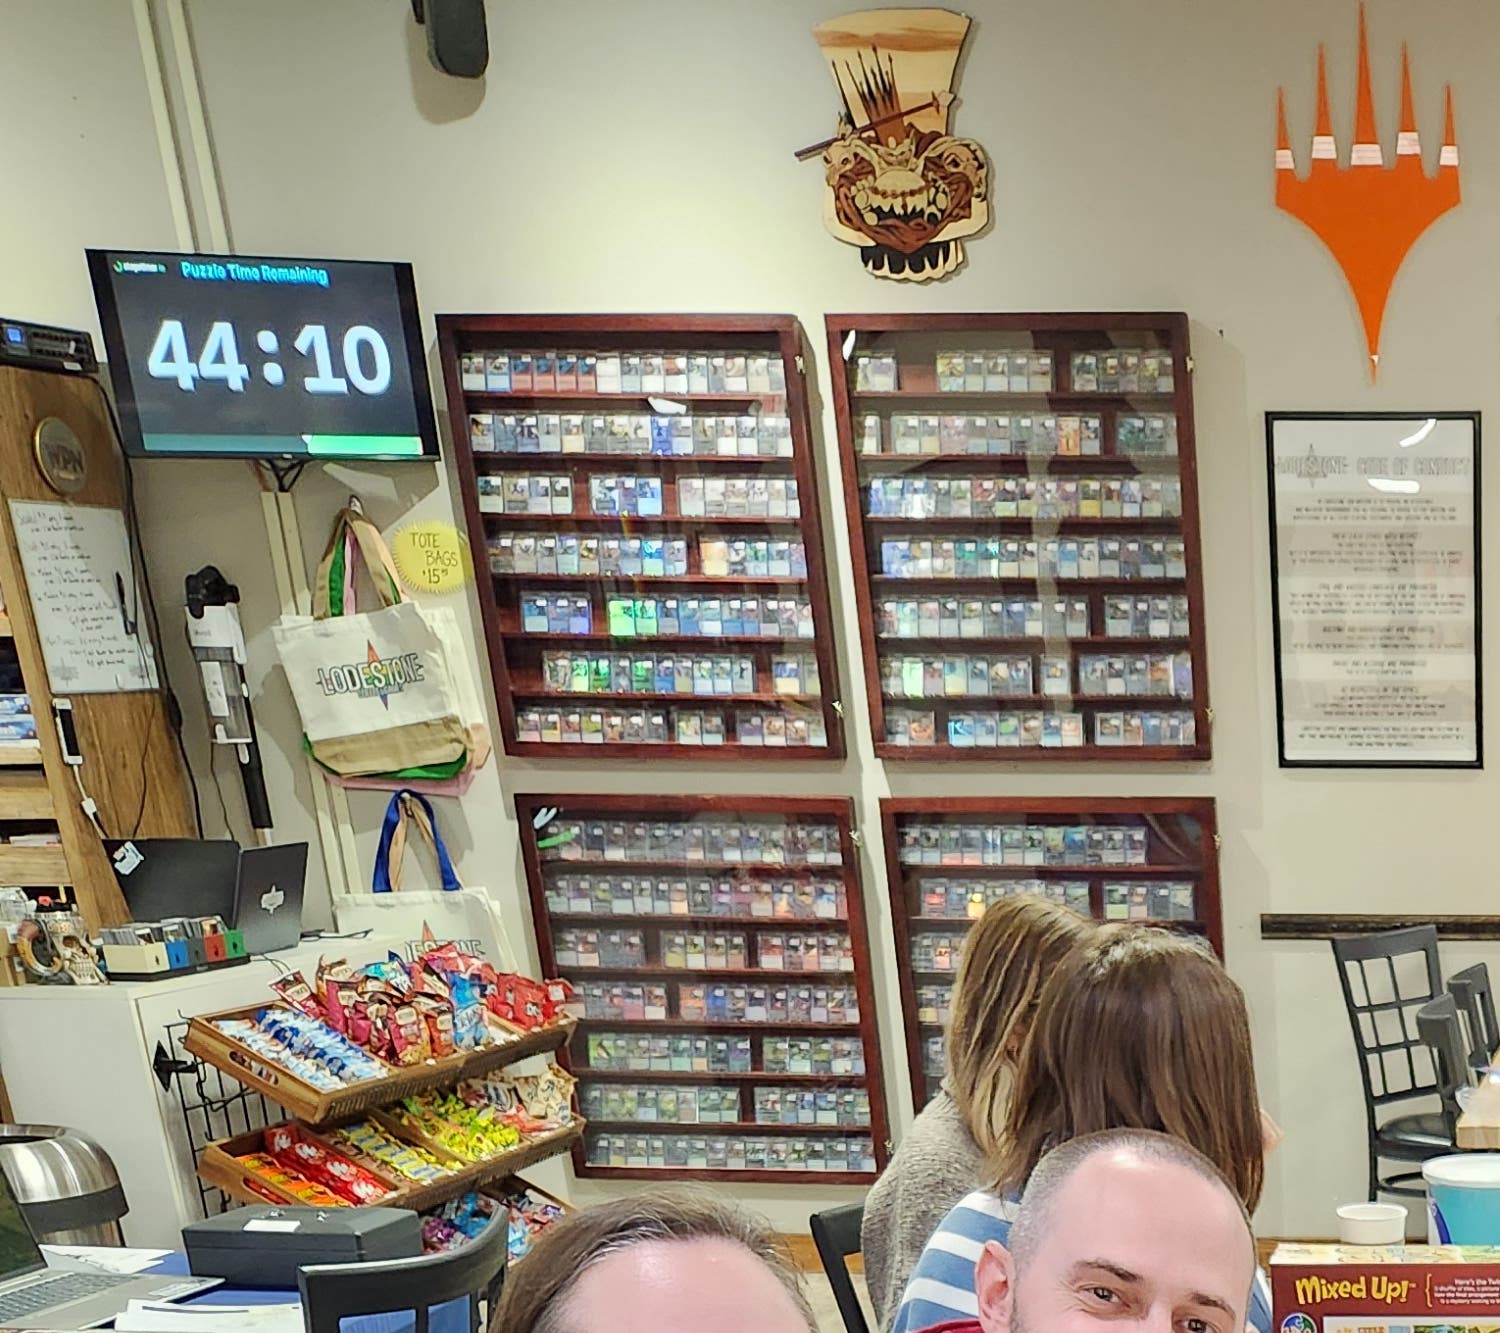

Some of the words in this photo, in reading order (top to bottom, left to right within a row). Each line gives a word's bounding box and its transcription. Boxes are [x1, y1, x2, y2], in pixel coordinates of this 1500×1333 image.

[180, 261, 227, 280] Puzzle
[227, 263, 260, 281] Time
[261, 265, 331, 288] Remaining
[148, 319, 391, 395] 44:10
[410, 532, 440, 548] TOTE
[426, 550, 458, 567] BAGS
[318, 653, 425, 696] LODESTONE
[1295, 1275, 1367, 1305] Mixed
